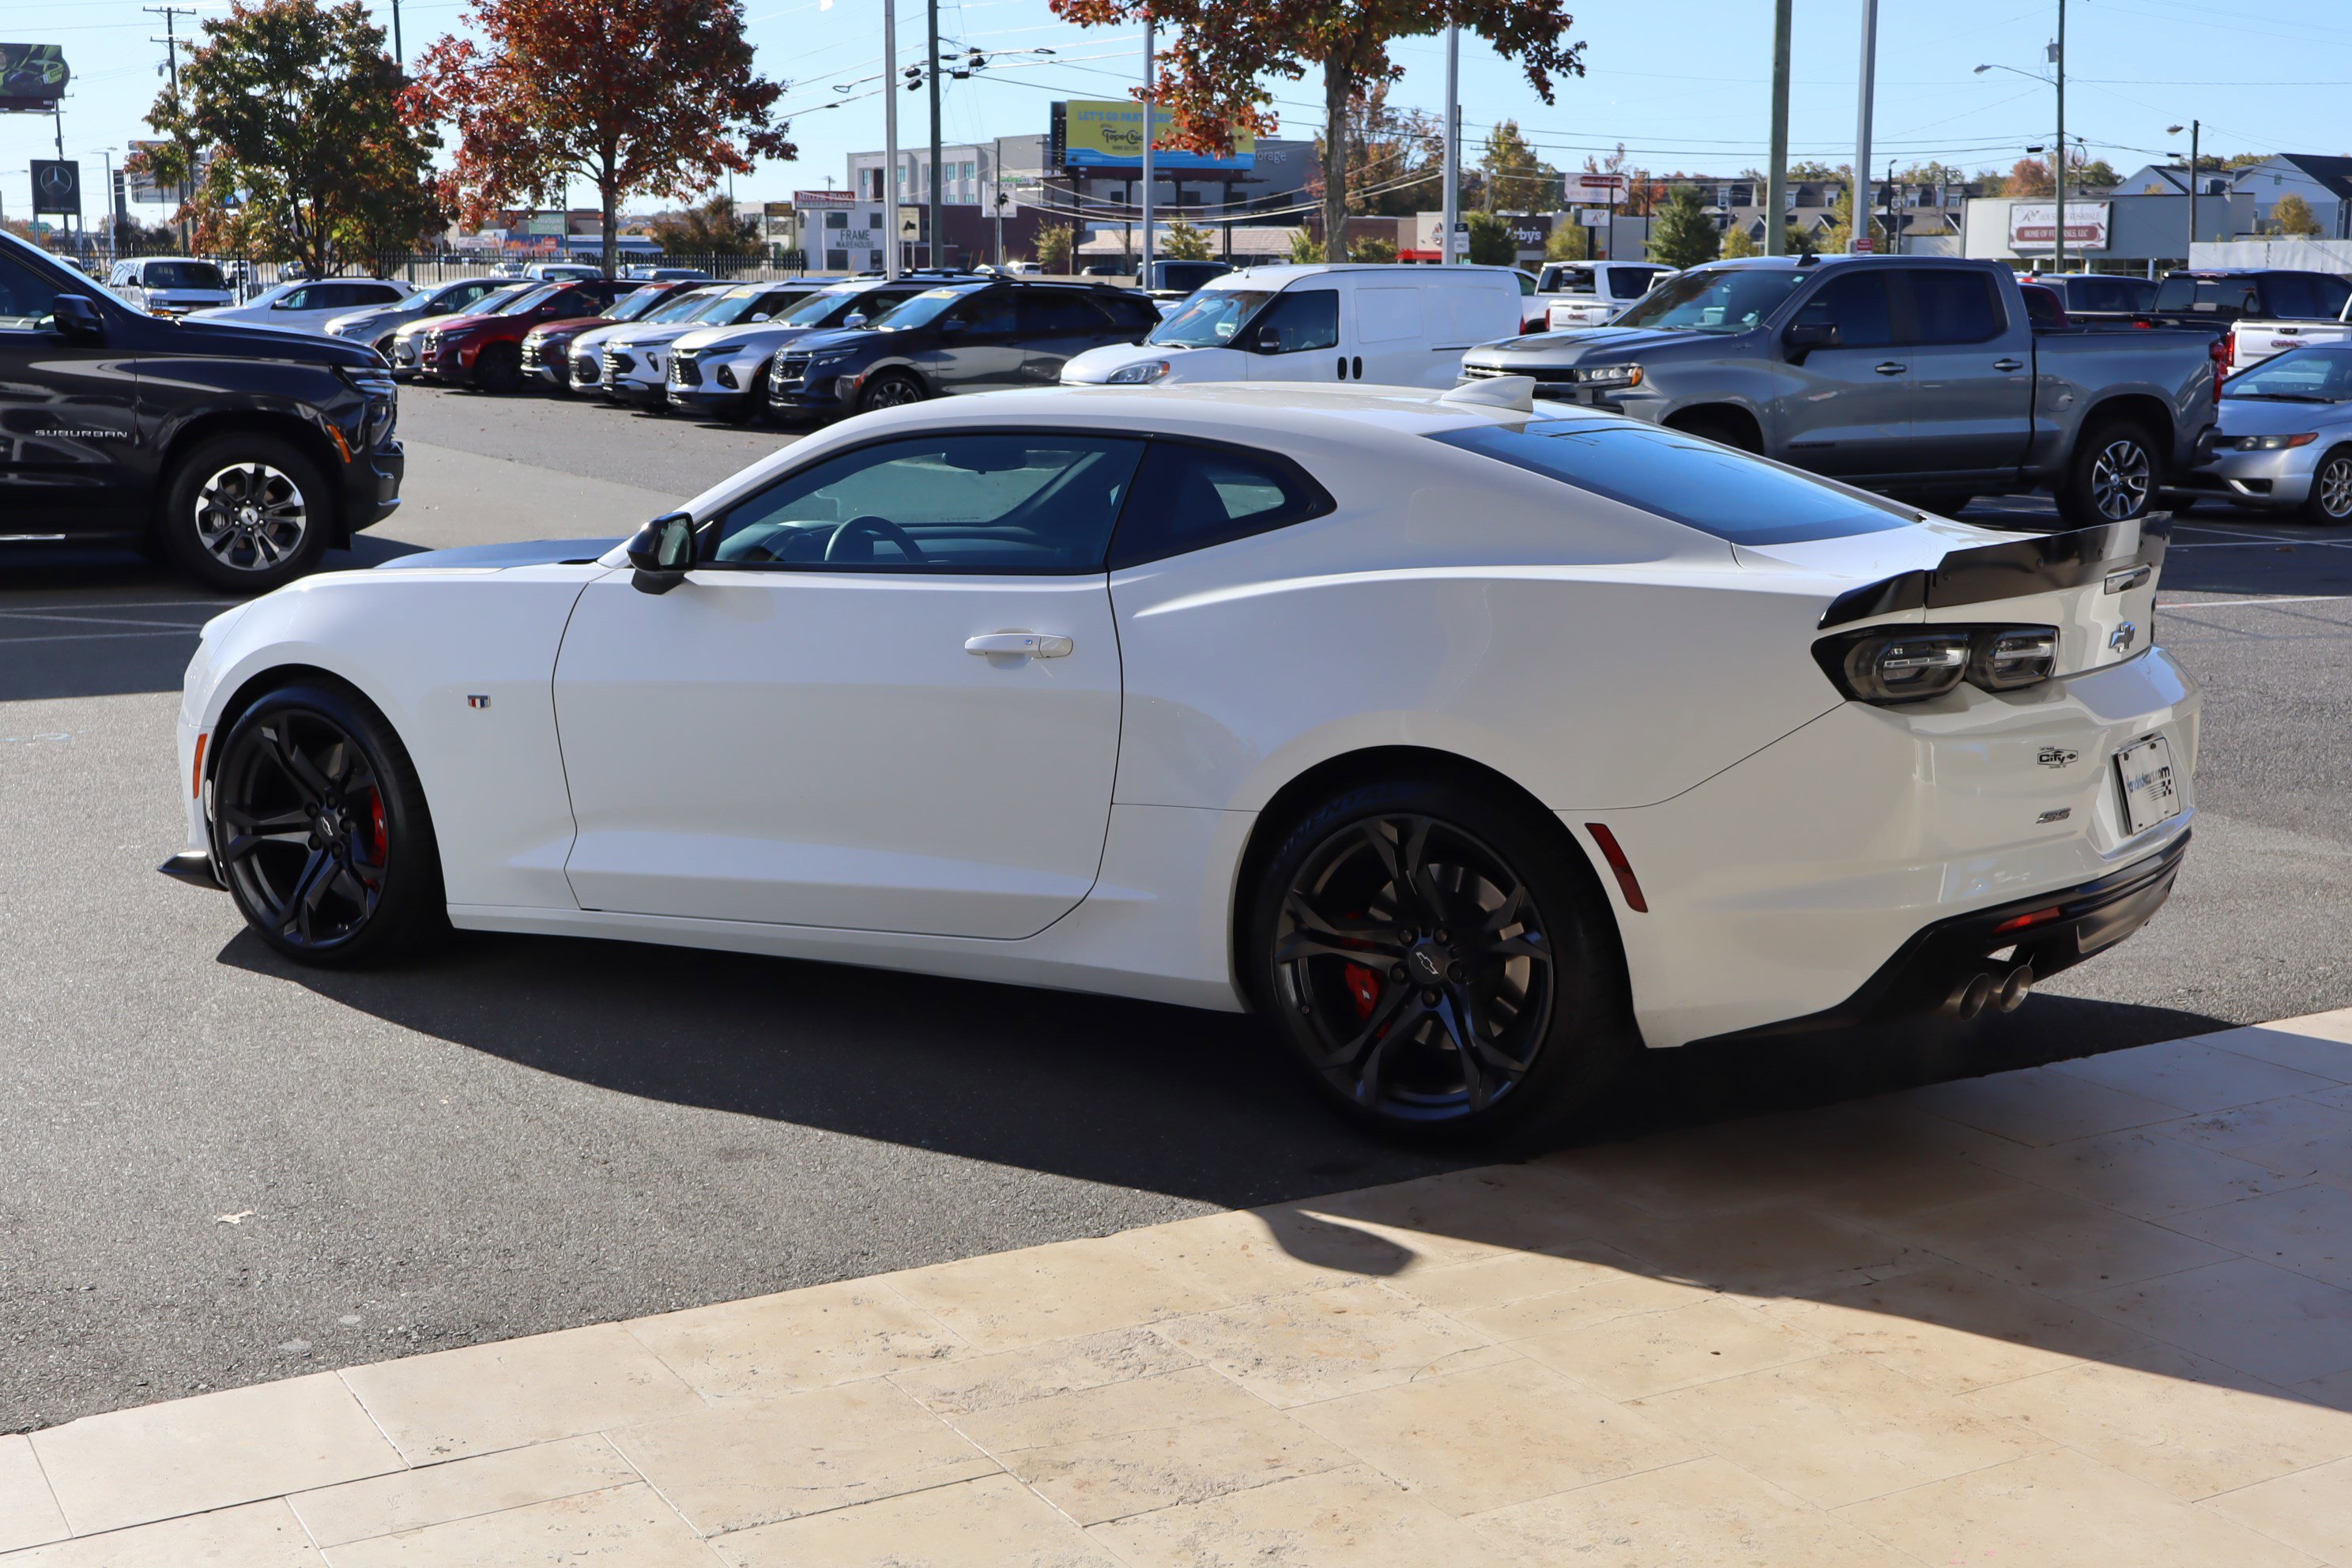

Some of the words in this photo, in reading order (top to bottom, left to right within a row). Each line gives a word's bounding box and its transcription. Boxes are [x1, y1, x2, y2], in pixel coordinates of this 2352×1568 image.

[1126, 129, 1144, 145] Chic
[1256, 150, 1287, 163] orage
[840, 230, 870, 240] FRAME
[35, 429, 127, 439] SUBURBAN
[2039, 752, 2066, 764] City
[2036, 807, 2072, 824] SS
